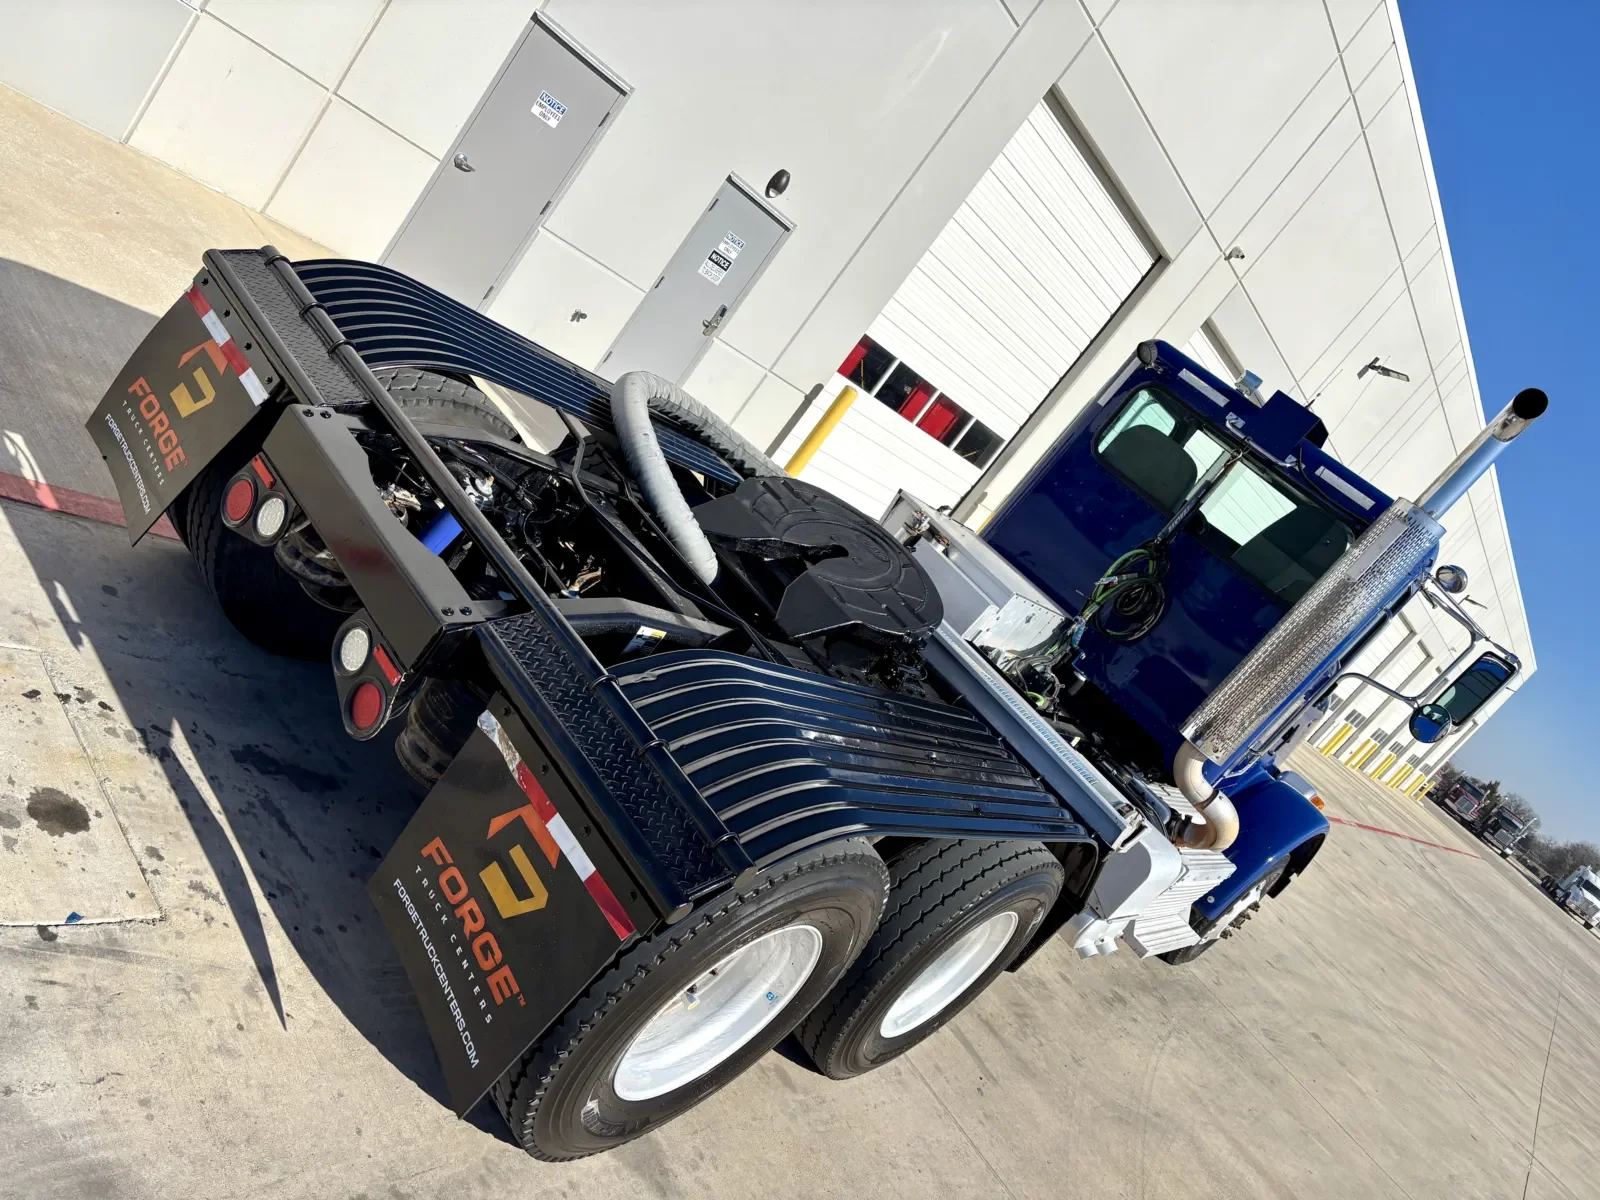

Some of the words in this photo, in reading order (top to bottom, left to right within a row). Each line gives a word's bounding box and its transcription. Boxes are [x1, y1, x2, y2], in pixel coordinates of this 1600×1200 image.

[535, 100, 561, 121] EMPLOYEES
[538, 110, 551, 121] ONLY
[540, 92, 567, 115] NOTICE
[710, 252, 730, 269] NOTICE
[726, 232, 745, 249] NOTICE
[104, 413, 151, 515] FORGETRUCKCENTERS.COM
[122, 400, 143, 435] TRUCK
[143, 438, 165, 486] CENTERS
[128, 376, 186, 472] FORGE
[415, 865, 448, 925] TRUCK
[450, 933, 493, 1024] CENTERS
[420, 836, 520, 1007] FORGE
[393, 878, 480, 1069] FORGETRUCKCENTERS.COM
